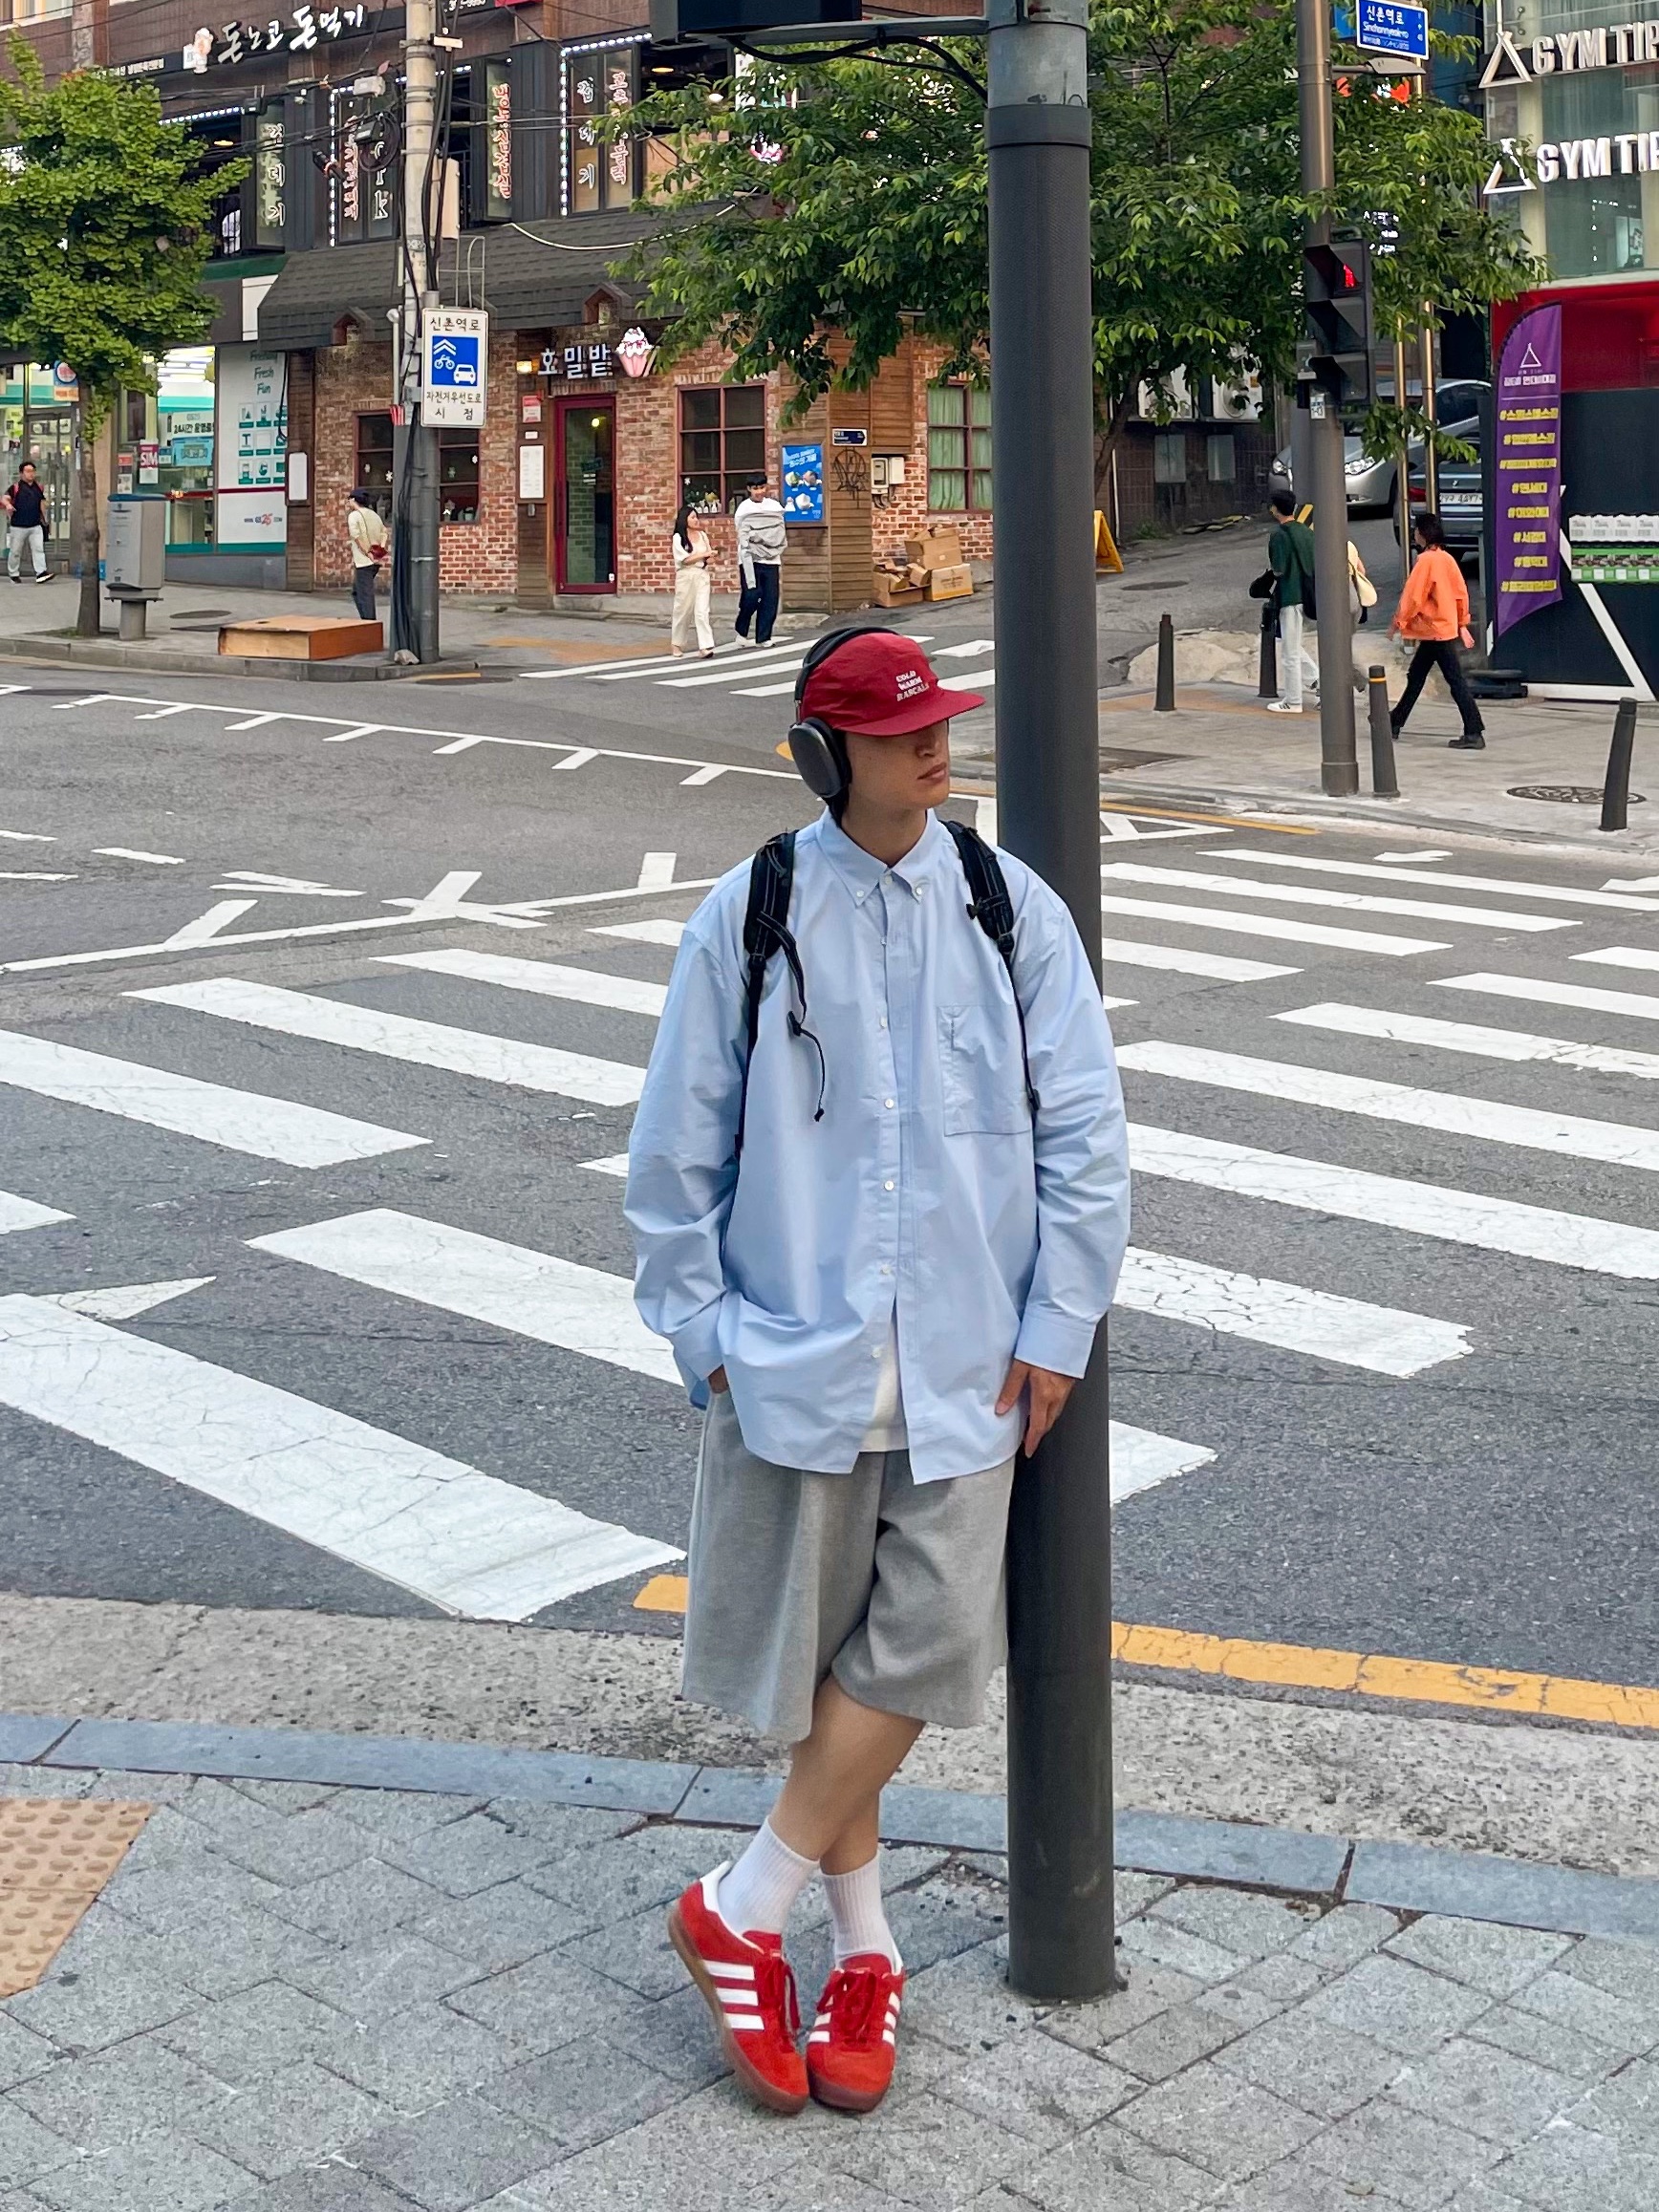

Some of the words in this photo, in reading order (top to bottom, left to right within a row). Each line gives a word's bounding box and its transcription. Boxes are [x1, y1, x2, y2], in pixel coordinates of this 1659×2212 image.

[290, 4, 365, 51] 돈먹기
[1532, 27, 1607, 75] GYM
[1537, 137, 1612, 183] GYM
[430, 316, 482, 332] 신촌역로
[254, 366, 275, 380] Fresh
[140, 452, 159, 466] SIM
[895, 670, 916, 682] COLD
[897, 676, 923, 691] WARM
